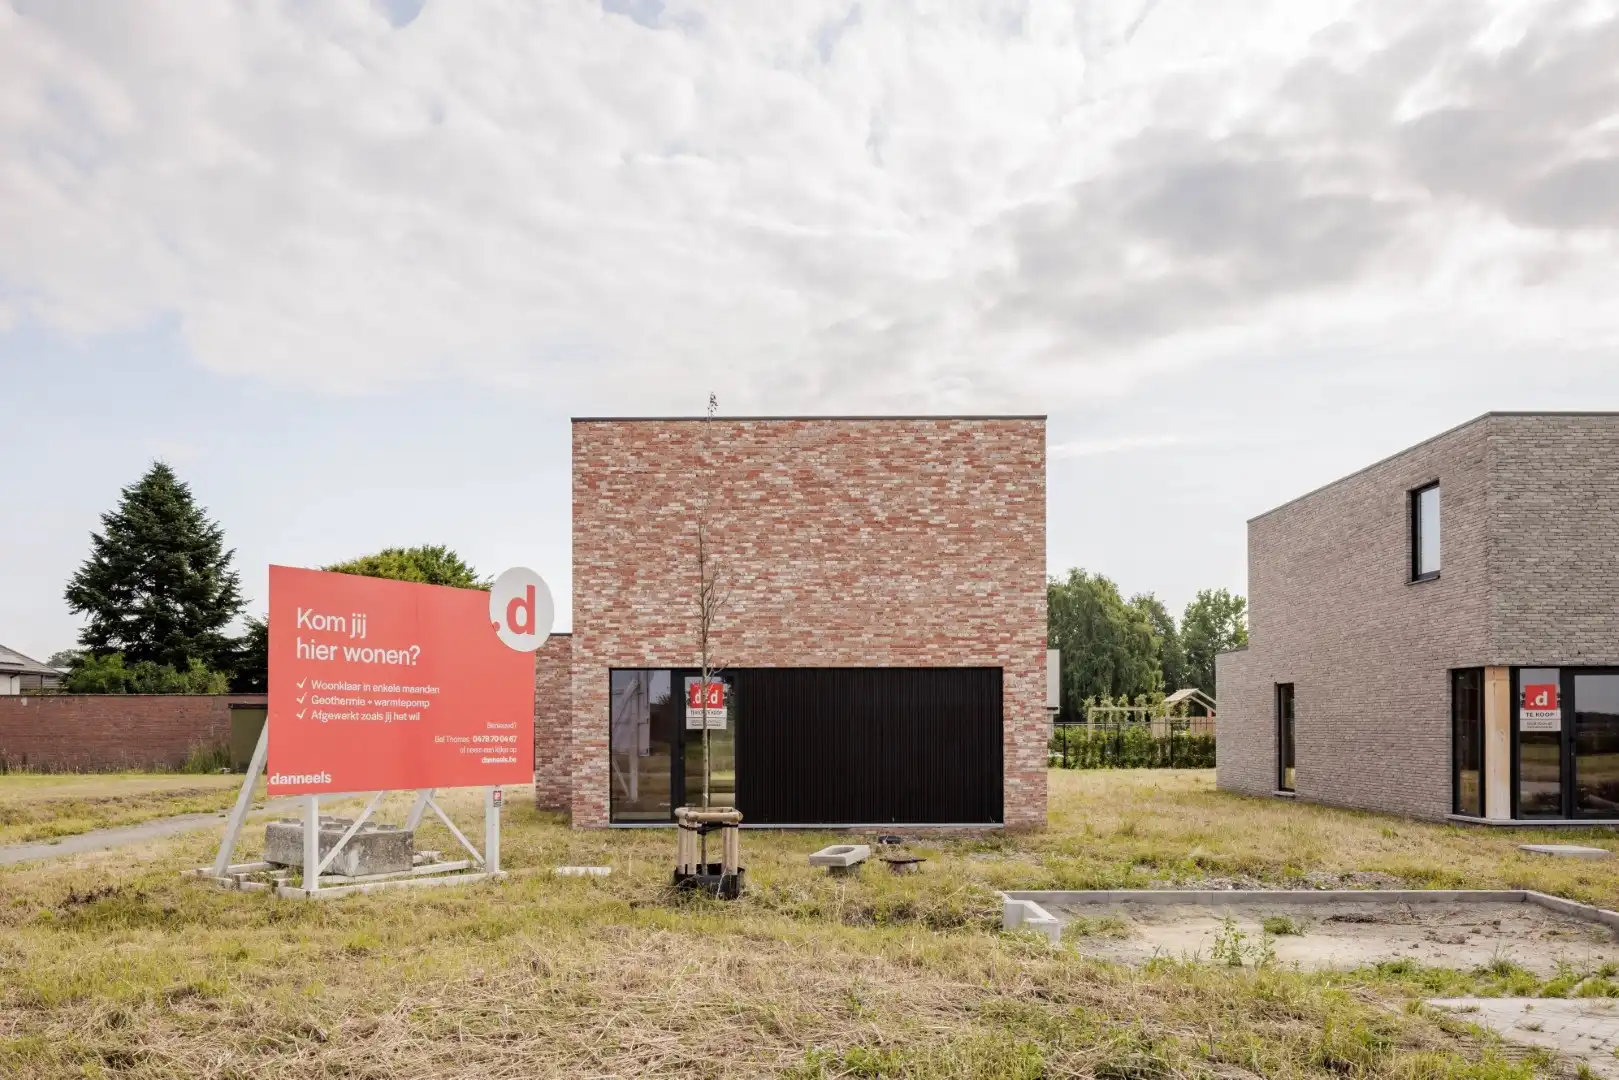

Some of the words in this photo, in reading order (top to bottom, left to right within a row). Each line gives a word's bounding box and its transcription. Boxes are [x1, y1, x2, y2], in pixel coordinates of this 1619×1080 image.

[297, 607, 346, 632] Kom
[350, 612, 367, 639] jij
[297, 637, 338, 661] hier
[343, 645, 421, 666] wonen?
[311, 679, 361, 691] Woonklaar
[363, 682, 371, 691] in
[373, 683, 400, 693] enkele
[402, 685, 440, 695] maanden
[311, 695, 366, 706] Geothermie
[374, 698, 430, 709] warmtepomp
[311, 709, 359, 722] Afgewerkt
[361, 711, 383, 721] zoals
[394, 712, 407, 721] het
[408, 712, 420, 721] wil
